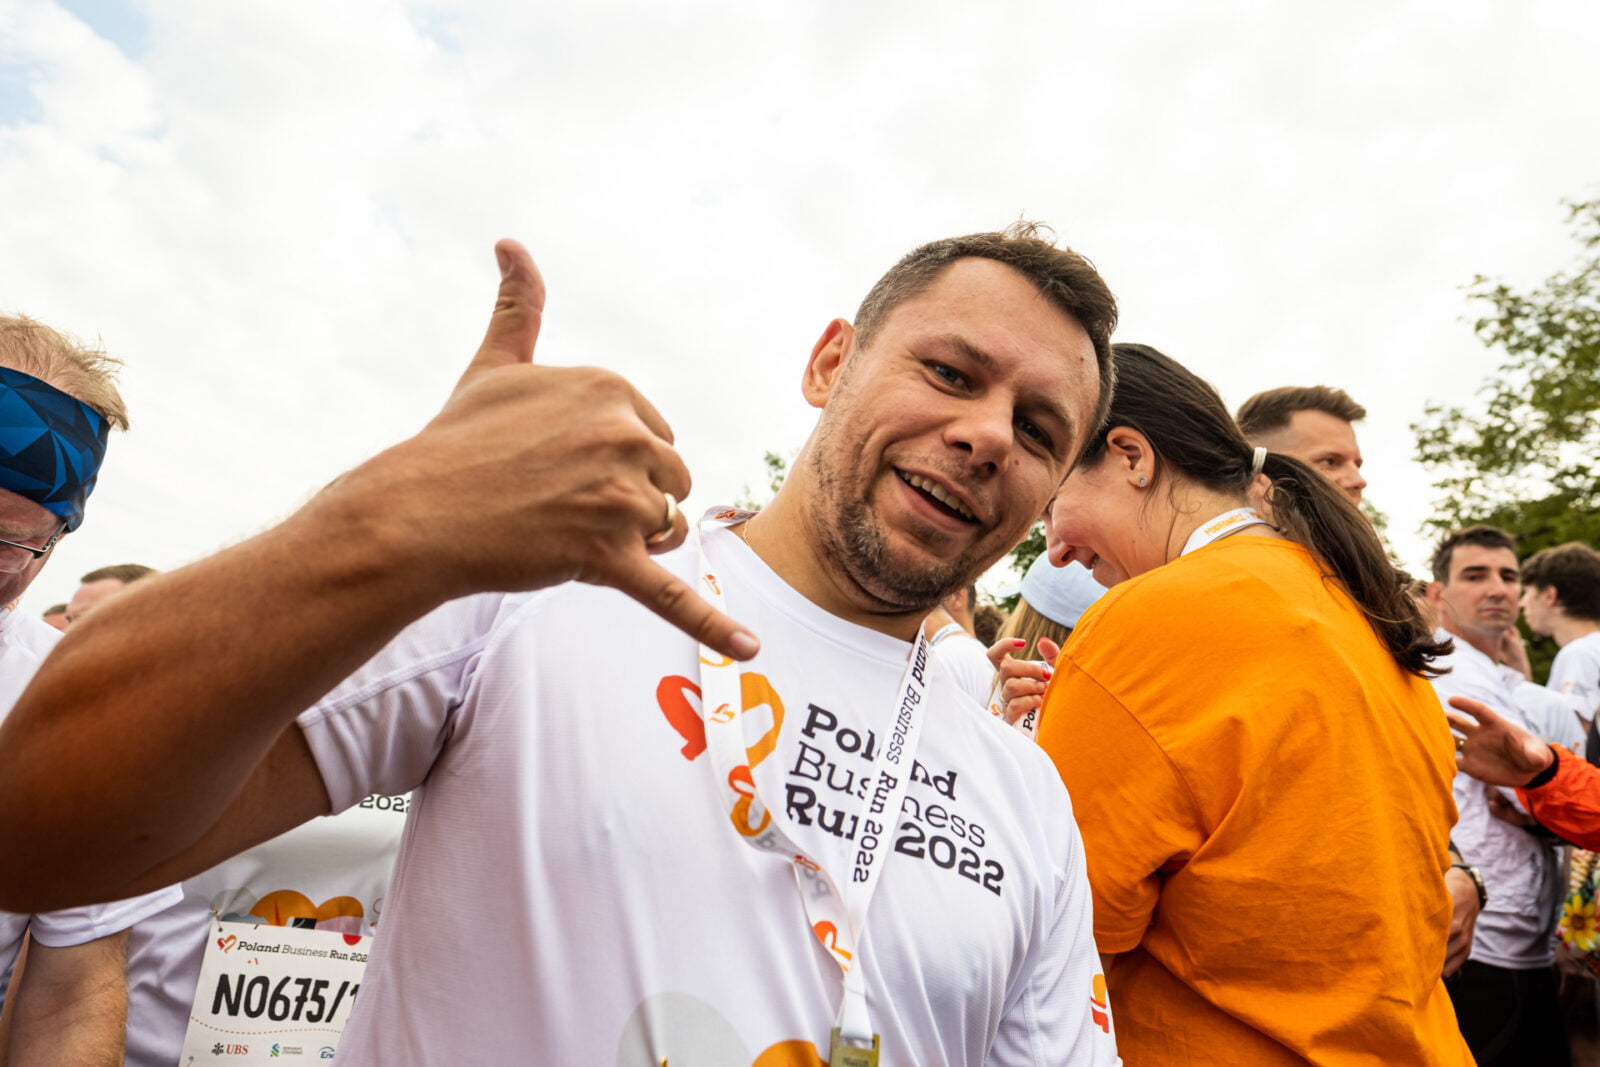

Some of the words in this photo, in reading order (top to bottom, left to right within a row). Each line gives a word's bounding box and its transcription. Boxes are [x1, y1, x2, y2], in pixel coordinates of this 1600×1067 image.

[801, 702, 958, 802] Polnd
[886, 683, 921, 766] Business
[358, 795, 410, 813] 202
[789, 740, 986, 848] Busness
[869, 770, 899, 815] Run
[852, 819, 884, 884] 2022
[894, 821, 1005, 897] 2022
[236, 940, 281, 954] Poland
[281, 944, 329, 959] Business
[328, 949, 349, 961] Run
[349, 952, 369, 963] 202
[225, 1044, 249, 1056] UBS
